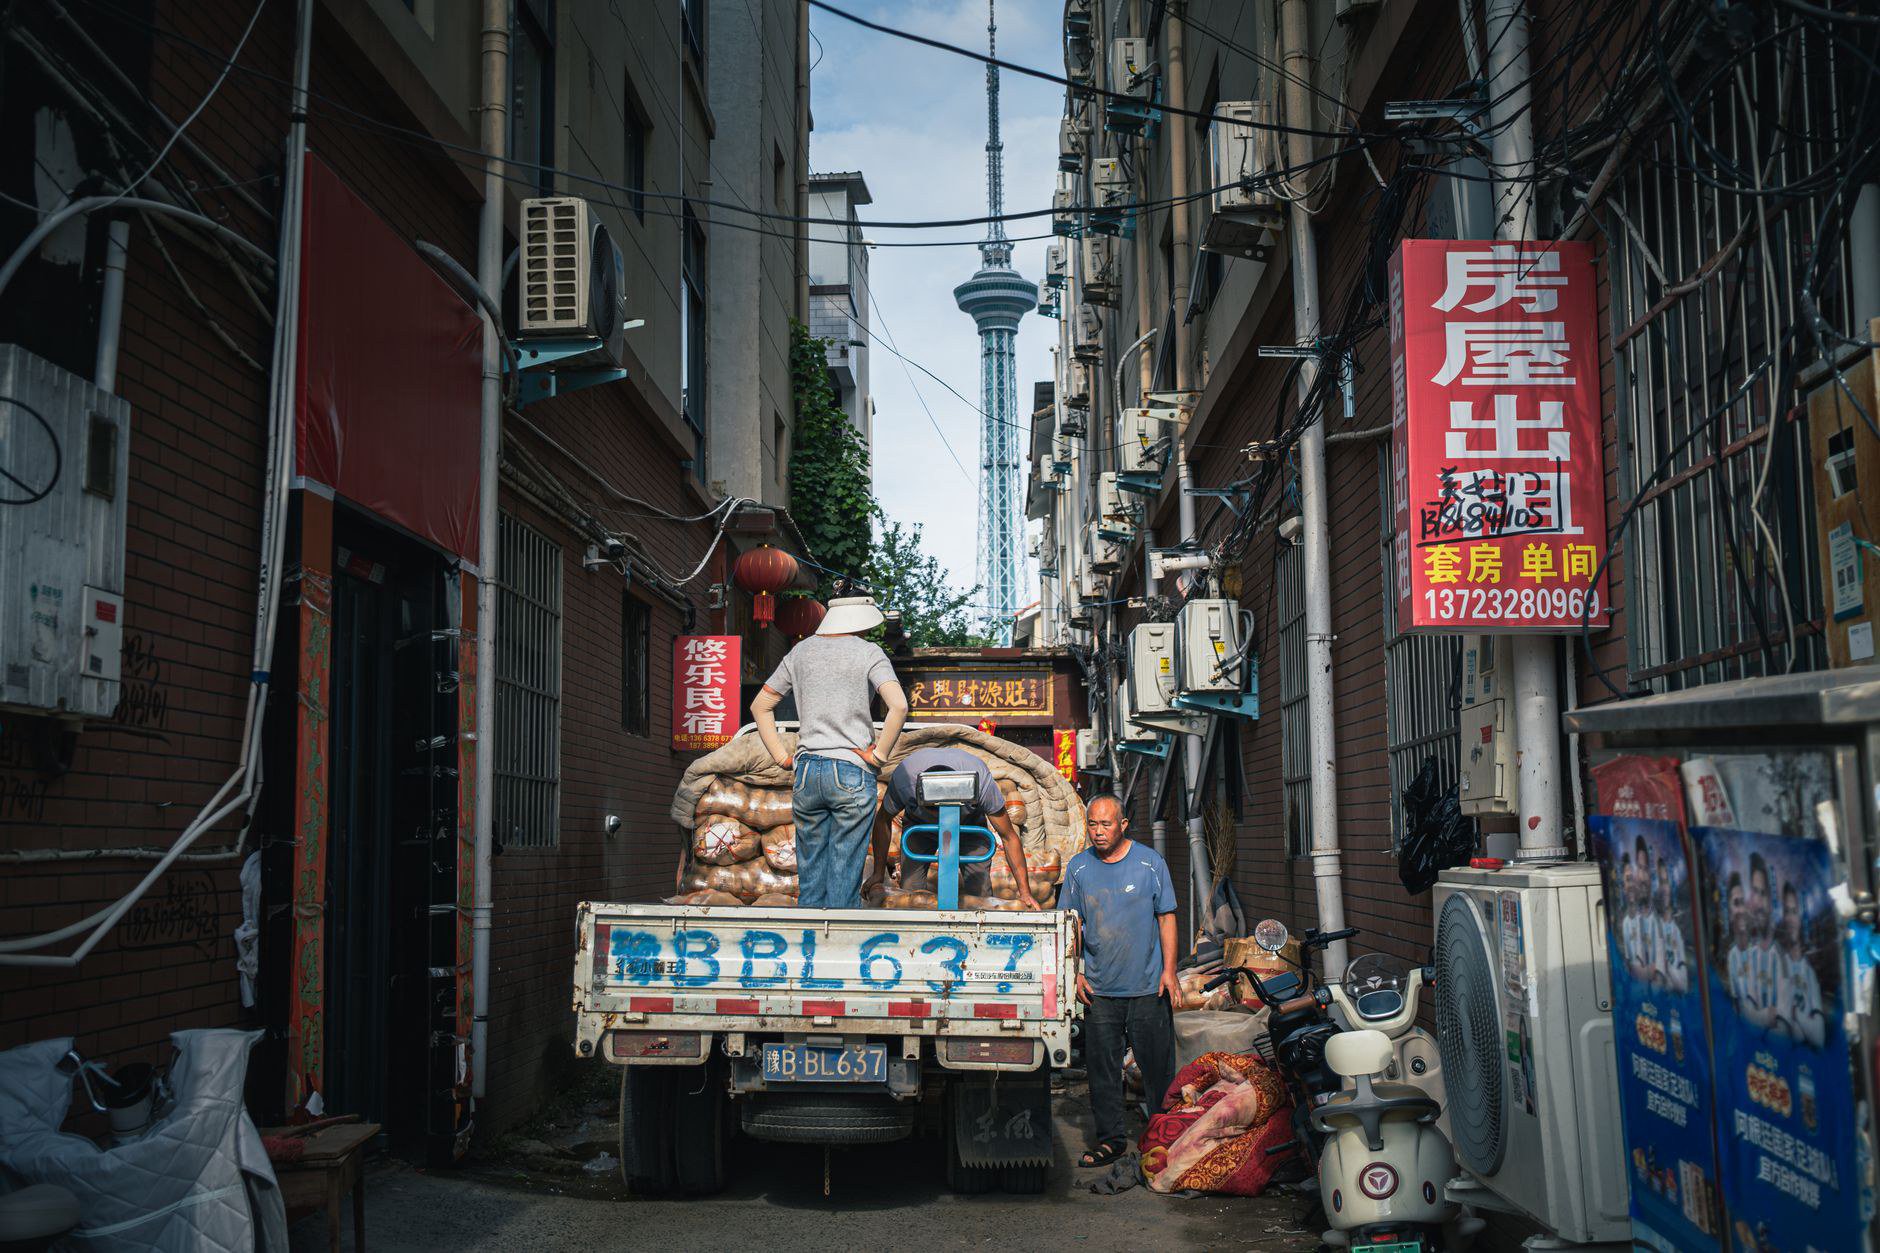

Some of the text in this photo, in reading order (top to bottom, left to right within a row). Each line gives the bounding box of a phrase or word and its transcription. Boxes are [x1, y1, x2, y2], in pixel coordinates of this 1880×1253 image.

[1390, 269, 1410, 603] 房屋出租
[1430, 244, 1584, 537] 房屋出租
[1424, 542, 1597, 585] 套房 单间
[1425, 588, 1599, 619] 13723280969
[682, 639, 727, 734] 悠乐民宿
